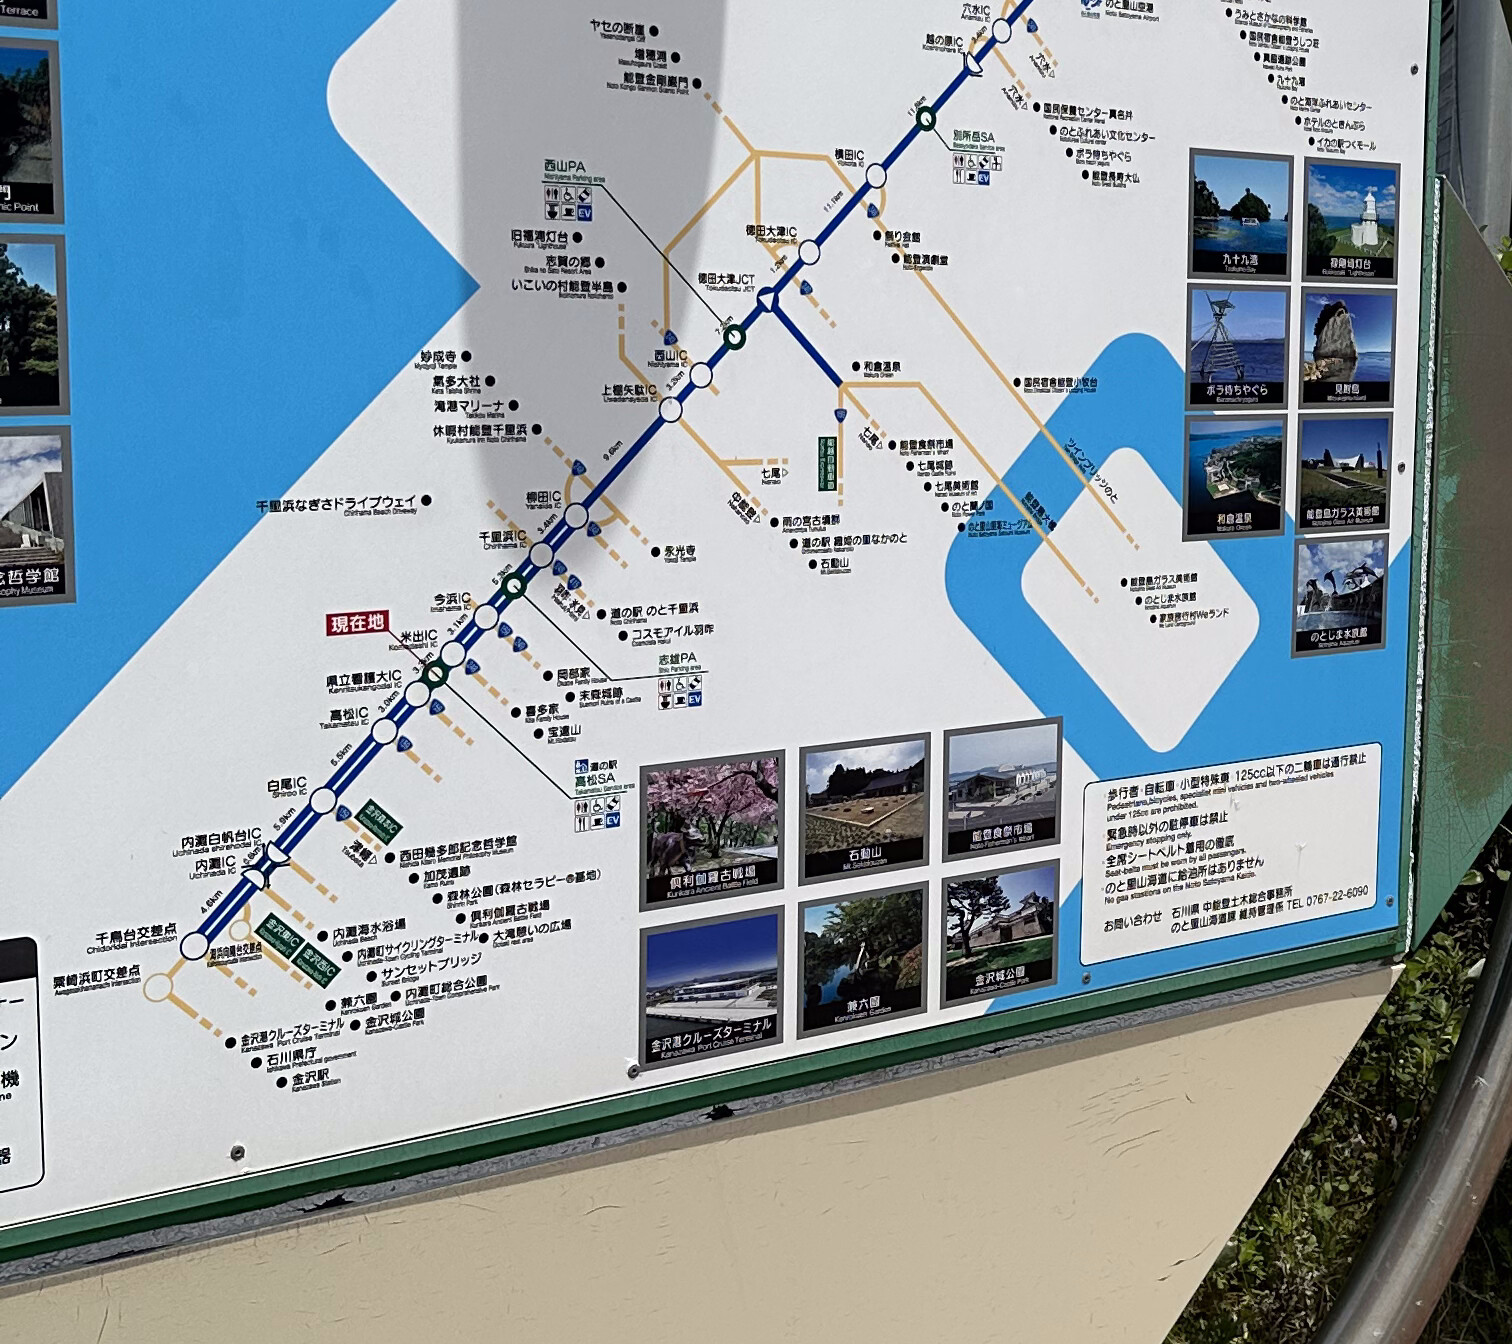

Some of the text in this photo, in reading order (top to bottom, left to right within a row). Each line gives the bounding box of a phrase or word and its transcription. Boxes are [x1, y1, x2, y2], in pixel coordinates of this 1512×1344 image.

[544, 159, 586, 173] 西山PA
[579, 209, 592, 219] EV
[654, 349, 688, 361] 西山IC
[256, 494, 416, 513] 千里浜なぎさドライブウェイ
[479, 530, 527, 542] 千里浜IC
[434, 592, 471, 604] 今浜IC
[610, 607, 642, 619] 道の駅
[331, 614, 385, 633] 現在地
[401, 629, 438, 643] 米出IC
[326, 670, 402, 688] 県立看護大IC
[689, 695, 701, 704] EV
[330, 707, 369, 721] 高松IC
[525, 703, 559, 717] 喜多家
[267, 776, 307, 792] 白尾IC
[575, 773, 616, 788] 高松SA
[606, 814, 620, 825] EV
[195, 856, 236, 872] 内灘IC
[1287, 899, 1303, 909] TEL
[1306, 884, 1369, 907] 0767-22-6090
[1104, 911, 1163, 932] お問い合わせ
[96, 922, 177, 945] 千鳥台交差点
[382, 952, 483, 980] サンセットブリッジ
